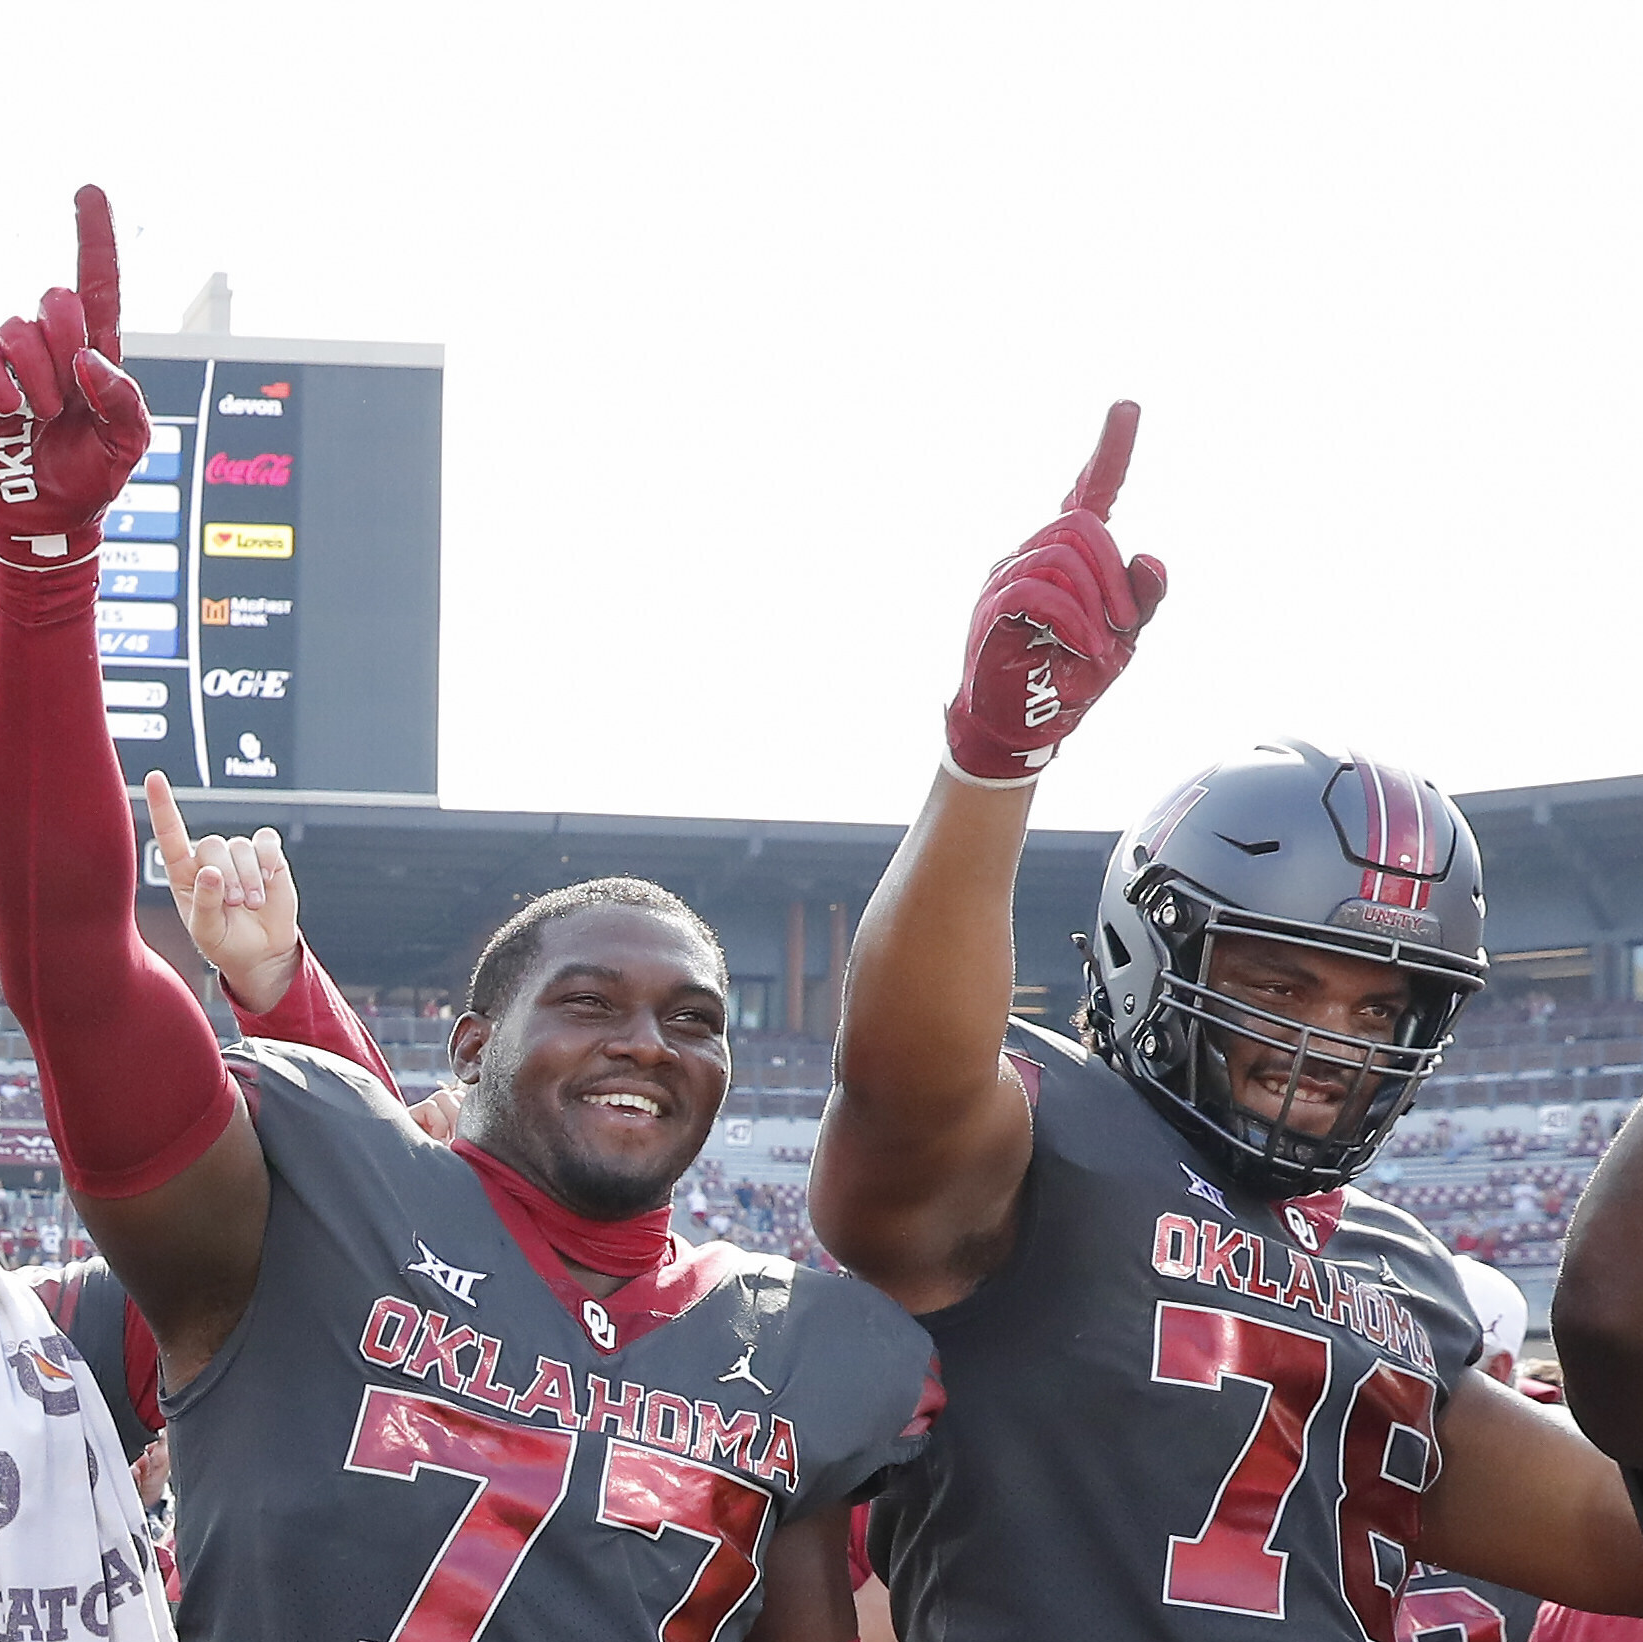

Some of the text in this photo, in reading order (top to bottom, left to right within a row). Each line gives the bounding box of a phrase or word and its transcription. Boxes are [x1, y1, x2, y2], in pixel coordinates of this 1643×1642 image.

[218, 394, 284, 417] devon
[1283, 1204, 1321, 1254] OU
[1150, 1211, 1439, 1373] OKLAHOMA
[581, 1298, 617, 1350] OU
[358, 1294, 801, 1495] OKLAHOMA
